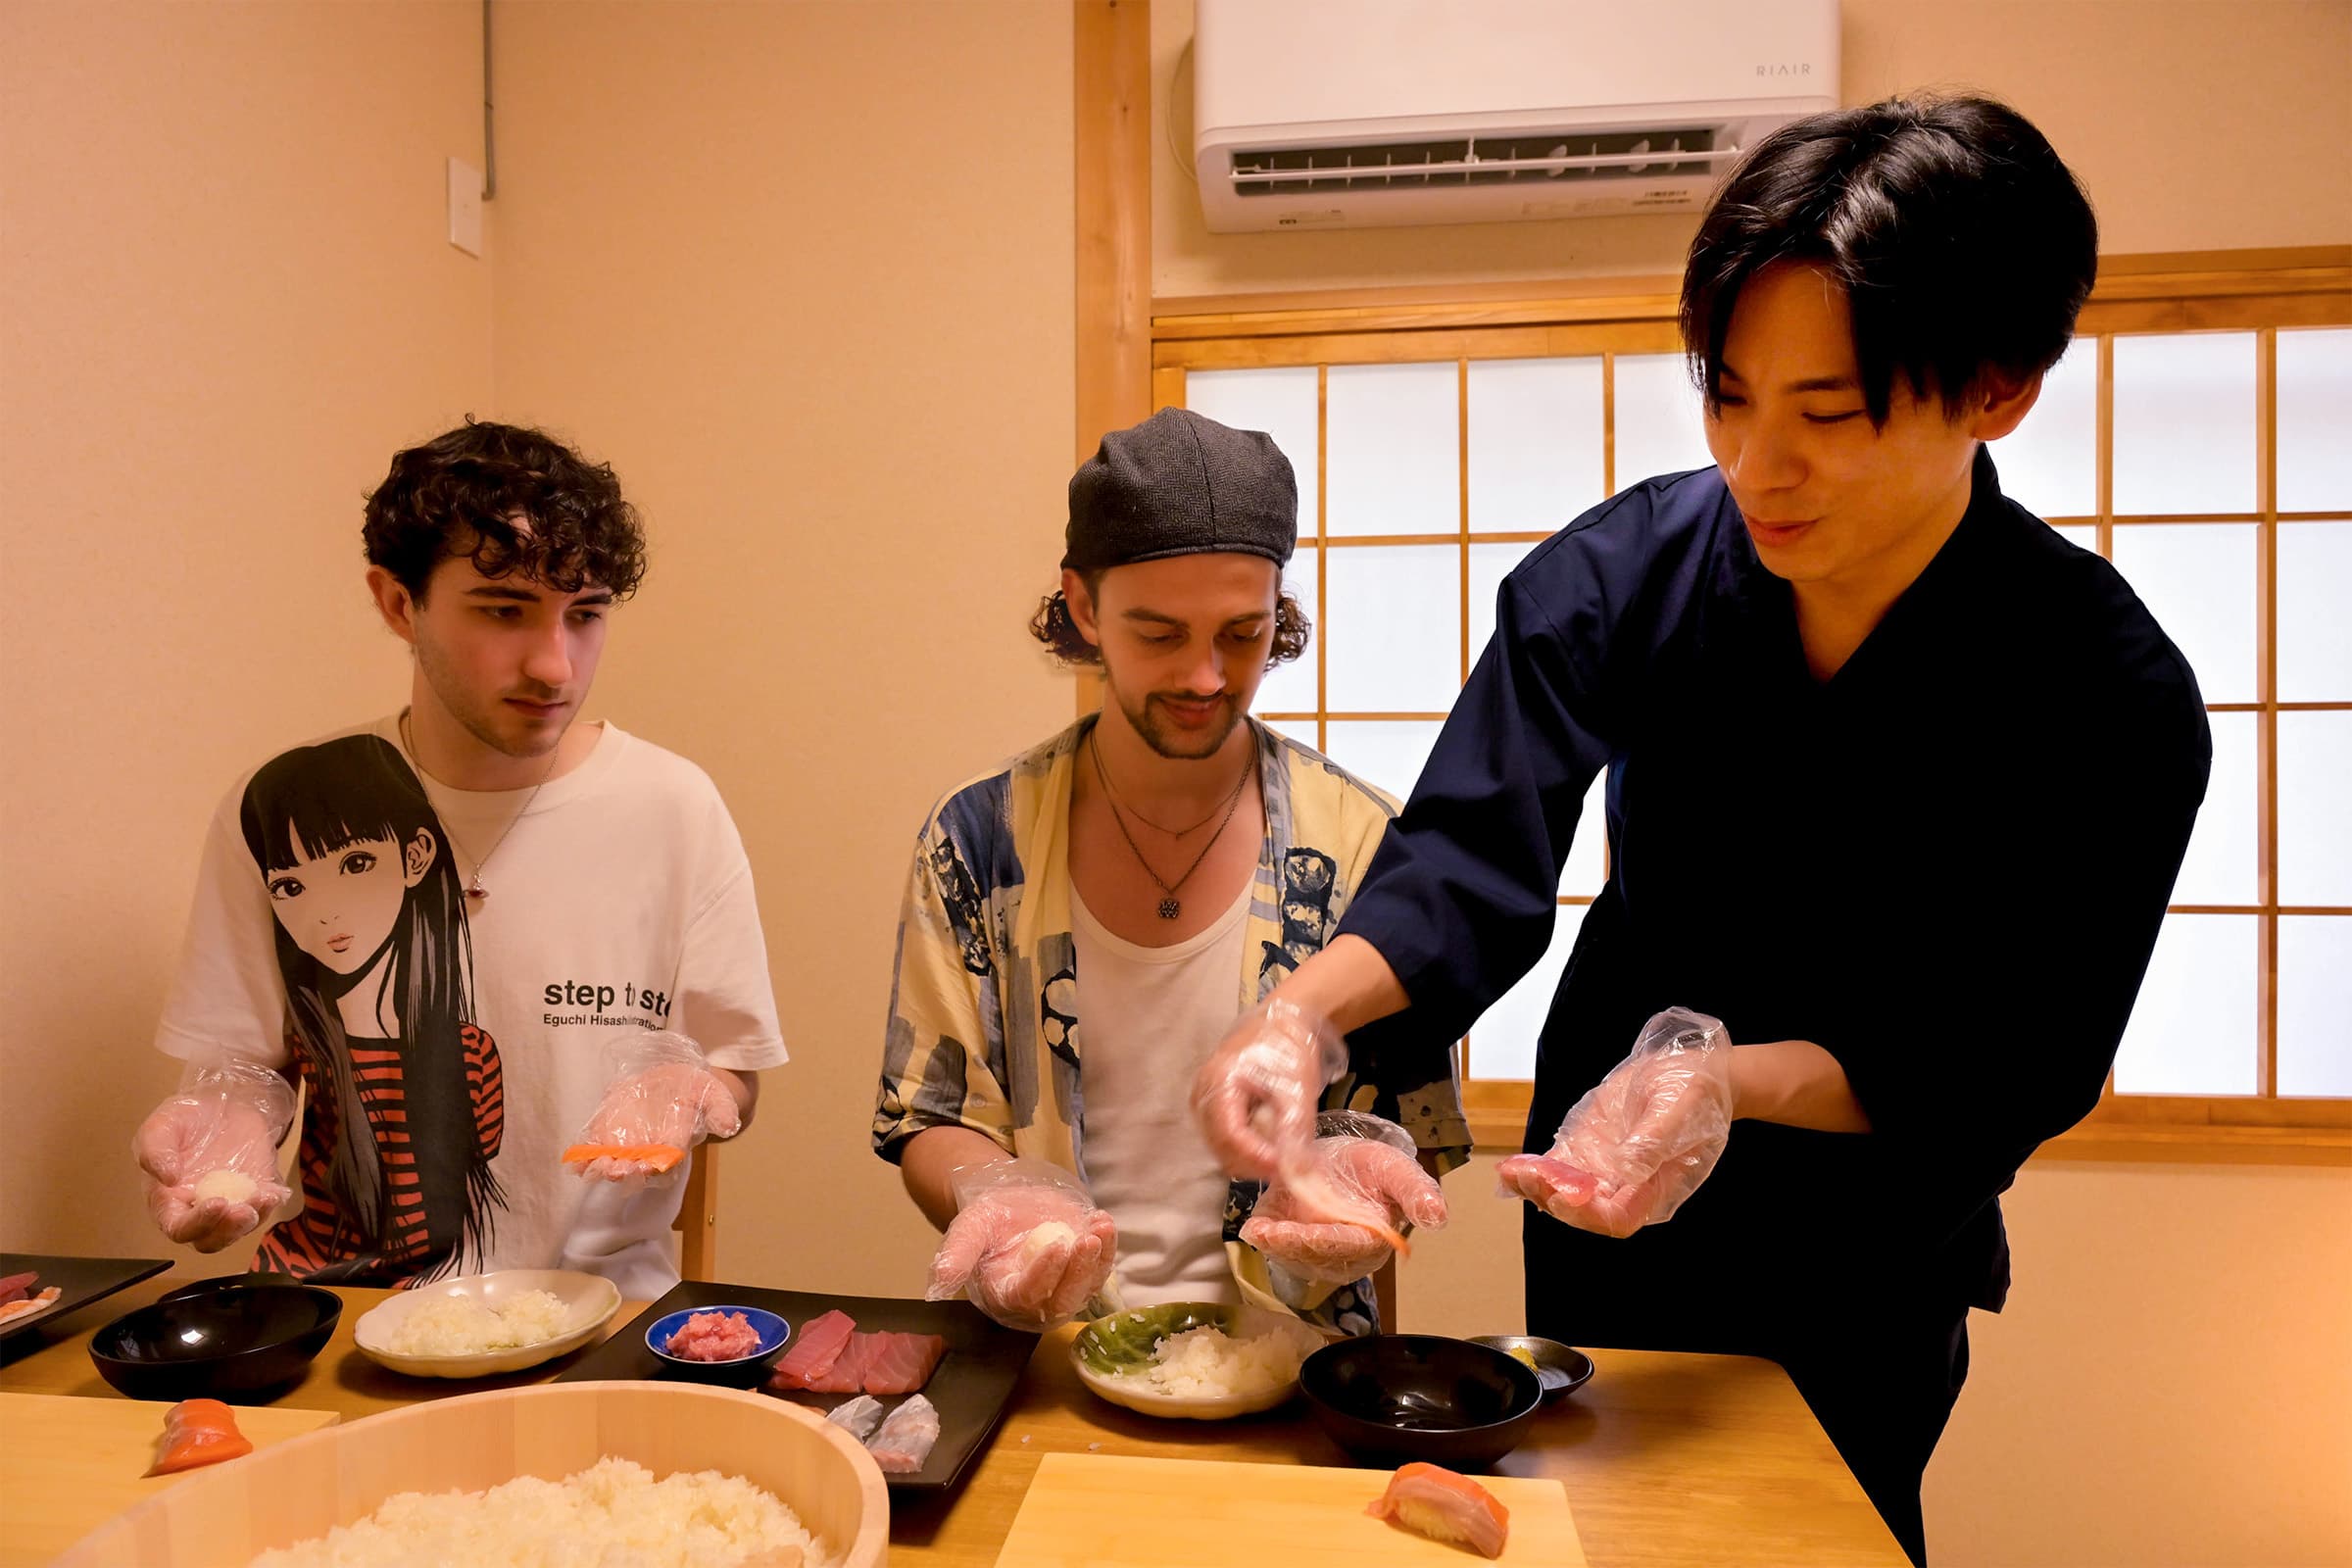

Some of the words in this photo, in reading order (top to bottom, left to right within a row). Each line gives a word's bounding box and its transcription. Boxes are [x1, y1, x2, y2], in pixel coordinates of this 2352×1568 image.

[544, 980, 614, 1012] step
[544, 1013, 586, 1026] Eguchi
[590, 1014, 627, 1026] Hisash
